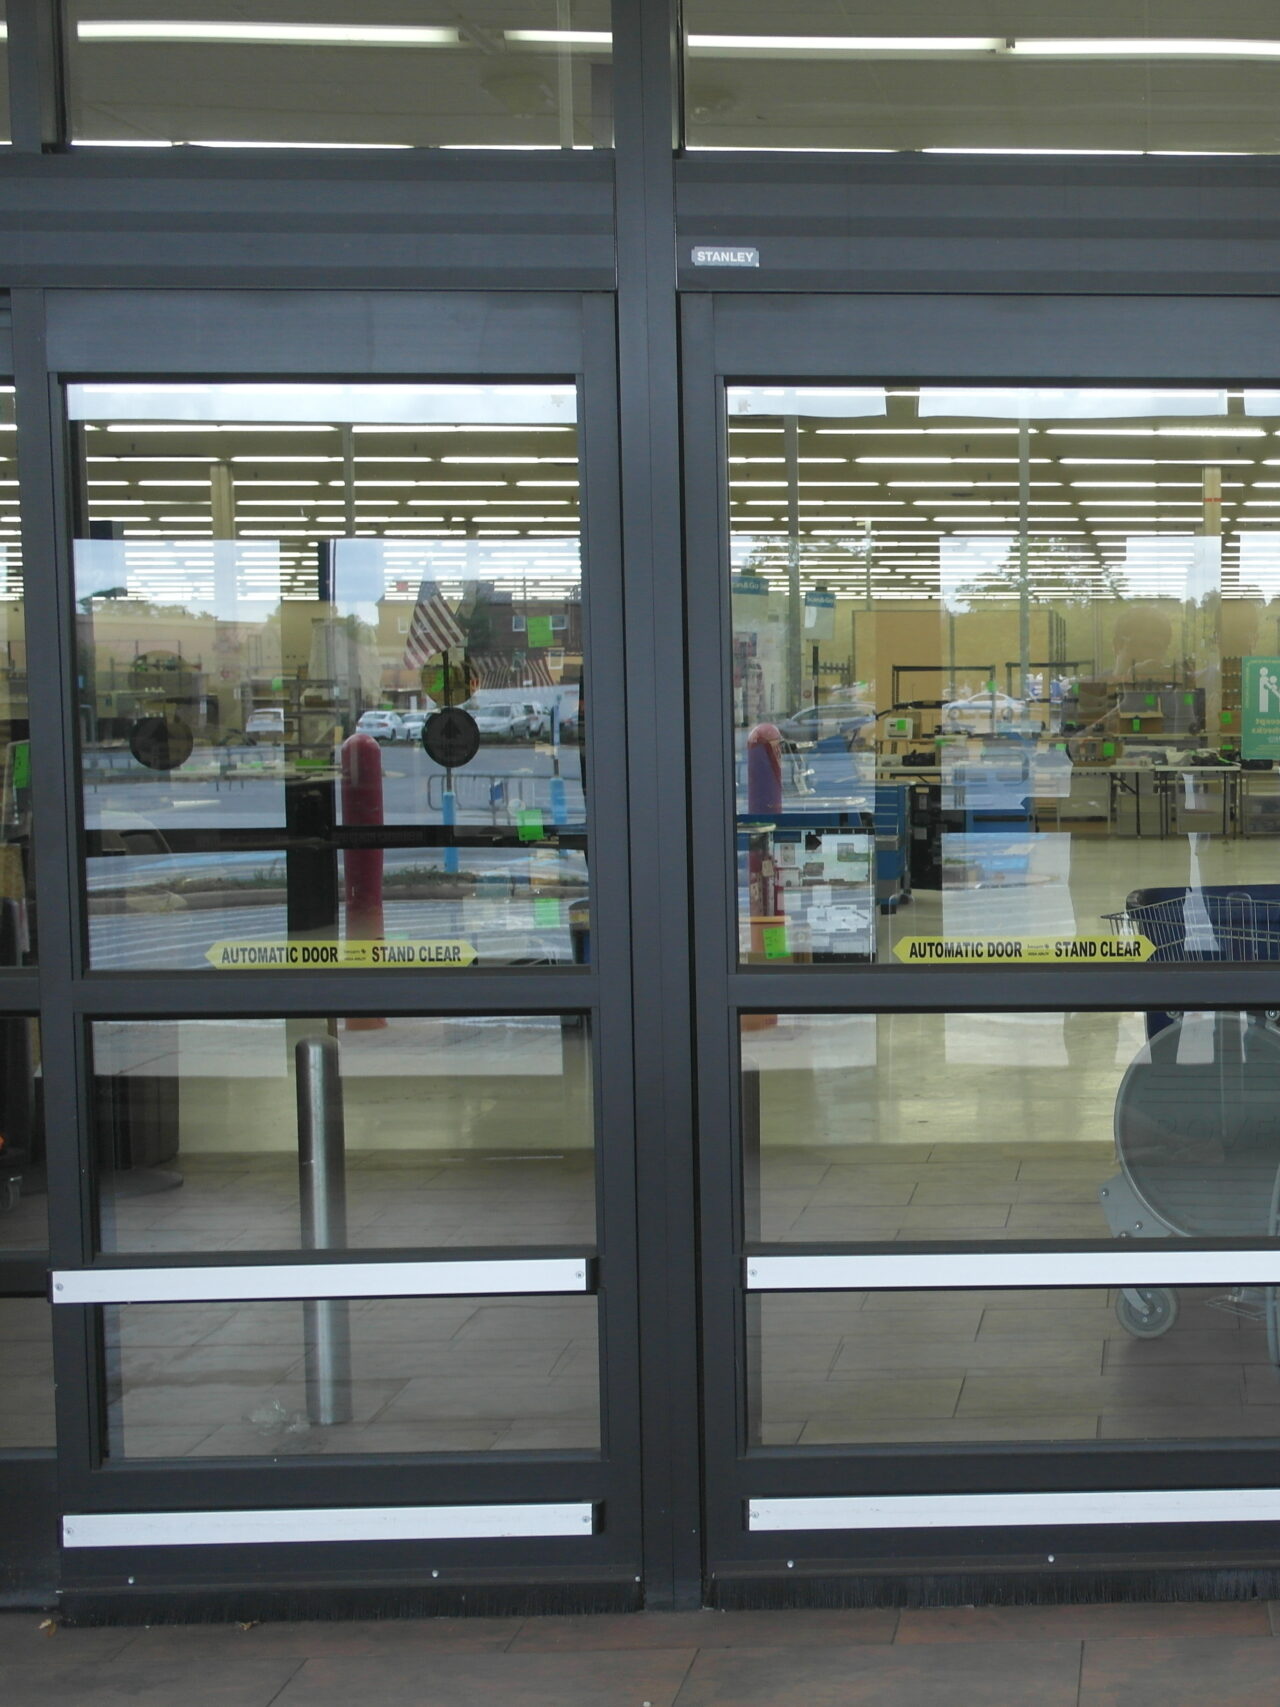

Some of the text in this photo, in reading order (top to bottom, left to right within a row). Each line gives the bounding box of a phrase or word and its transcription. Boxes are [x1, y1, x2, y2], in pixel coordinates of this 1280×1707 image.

[697, 251, 754, 262] STANLEY
[221, 945, 462, 964] AUTOMATIC DOOR STAND CLEAR
[909, 940, 1141, 958] AUTOMATIC DOOR STAND CLEAR
